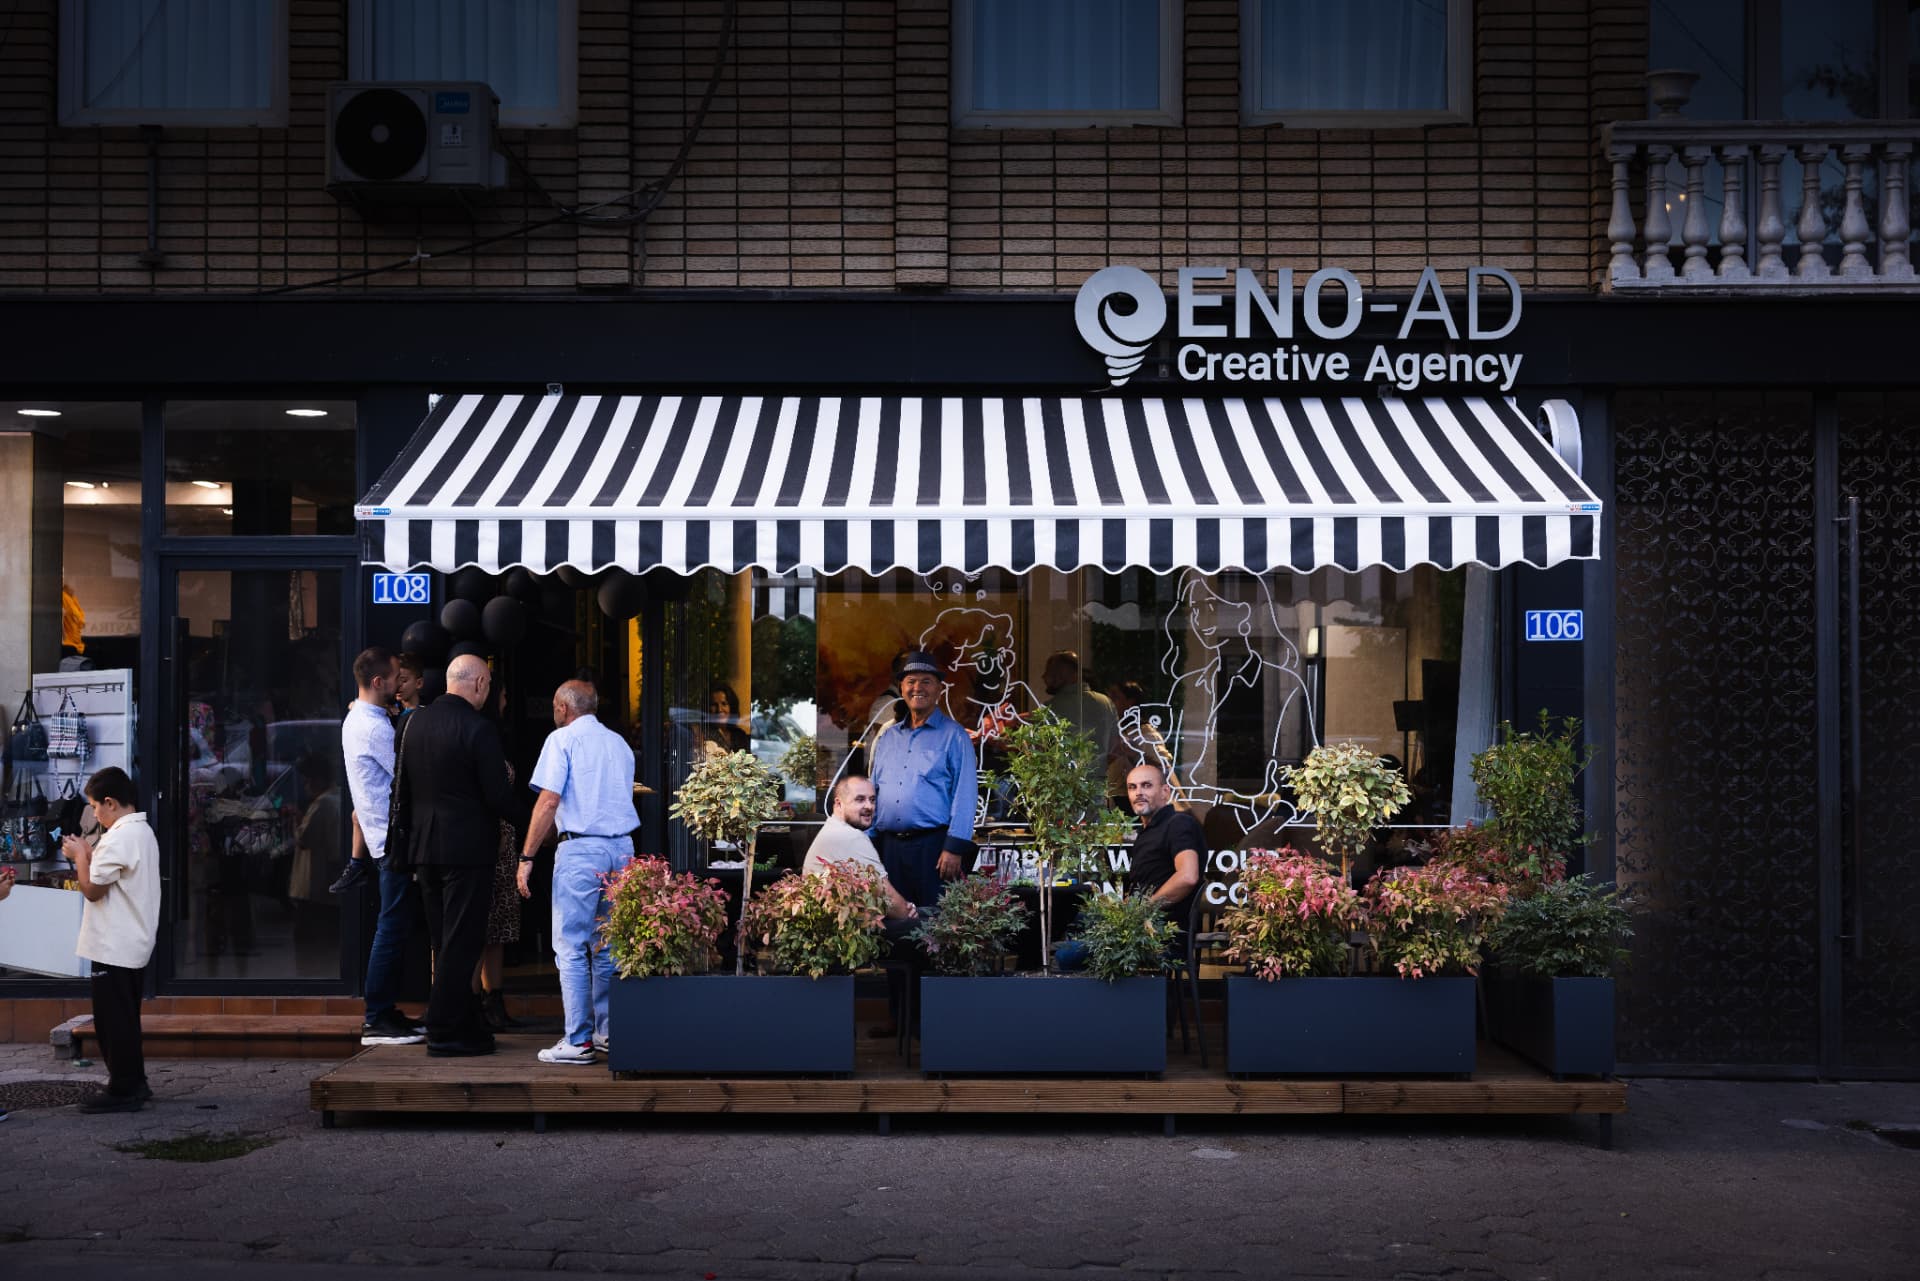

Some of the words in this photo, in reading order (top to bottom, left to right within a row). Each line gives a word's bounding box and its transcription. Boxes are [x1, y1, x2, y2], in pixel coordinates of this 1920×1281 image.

[1177, 265, 1523, 340] ENO-AD
[1177, 343, 1350, 382] Creative
[1363, 344, 1524, 391] Agency
[378, 575, 427, 602] 108
[1530, 612, 1580, 639] 106
